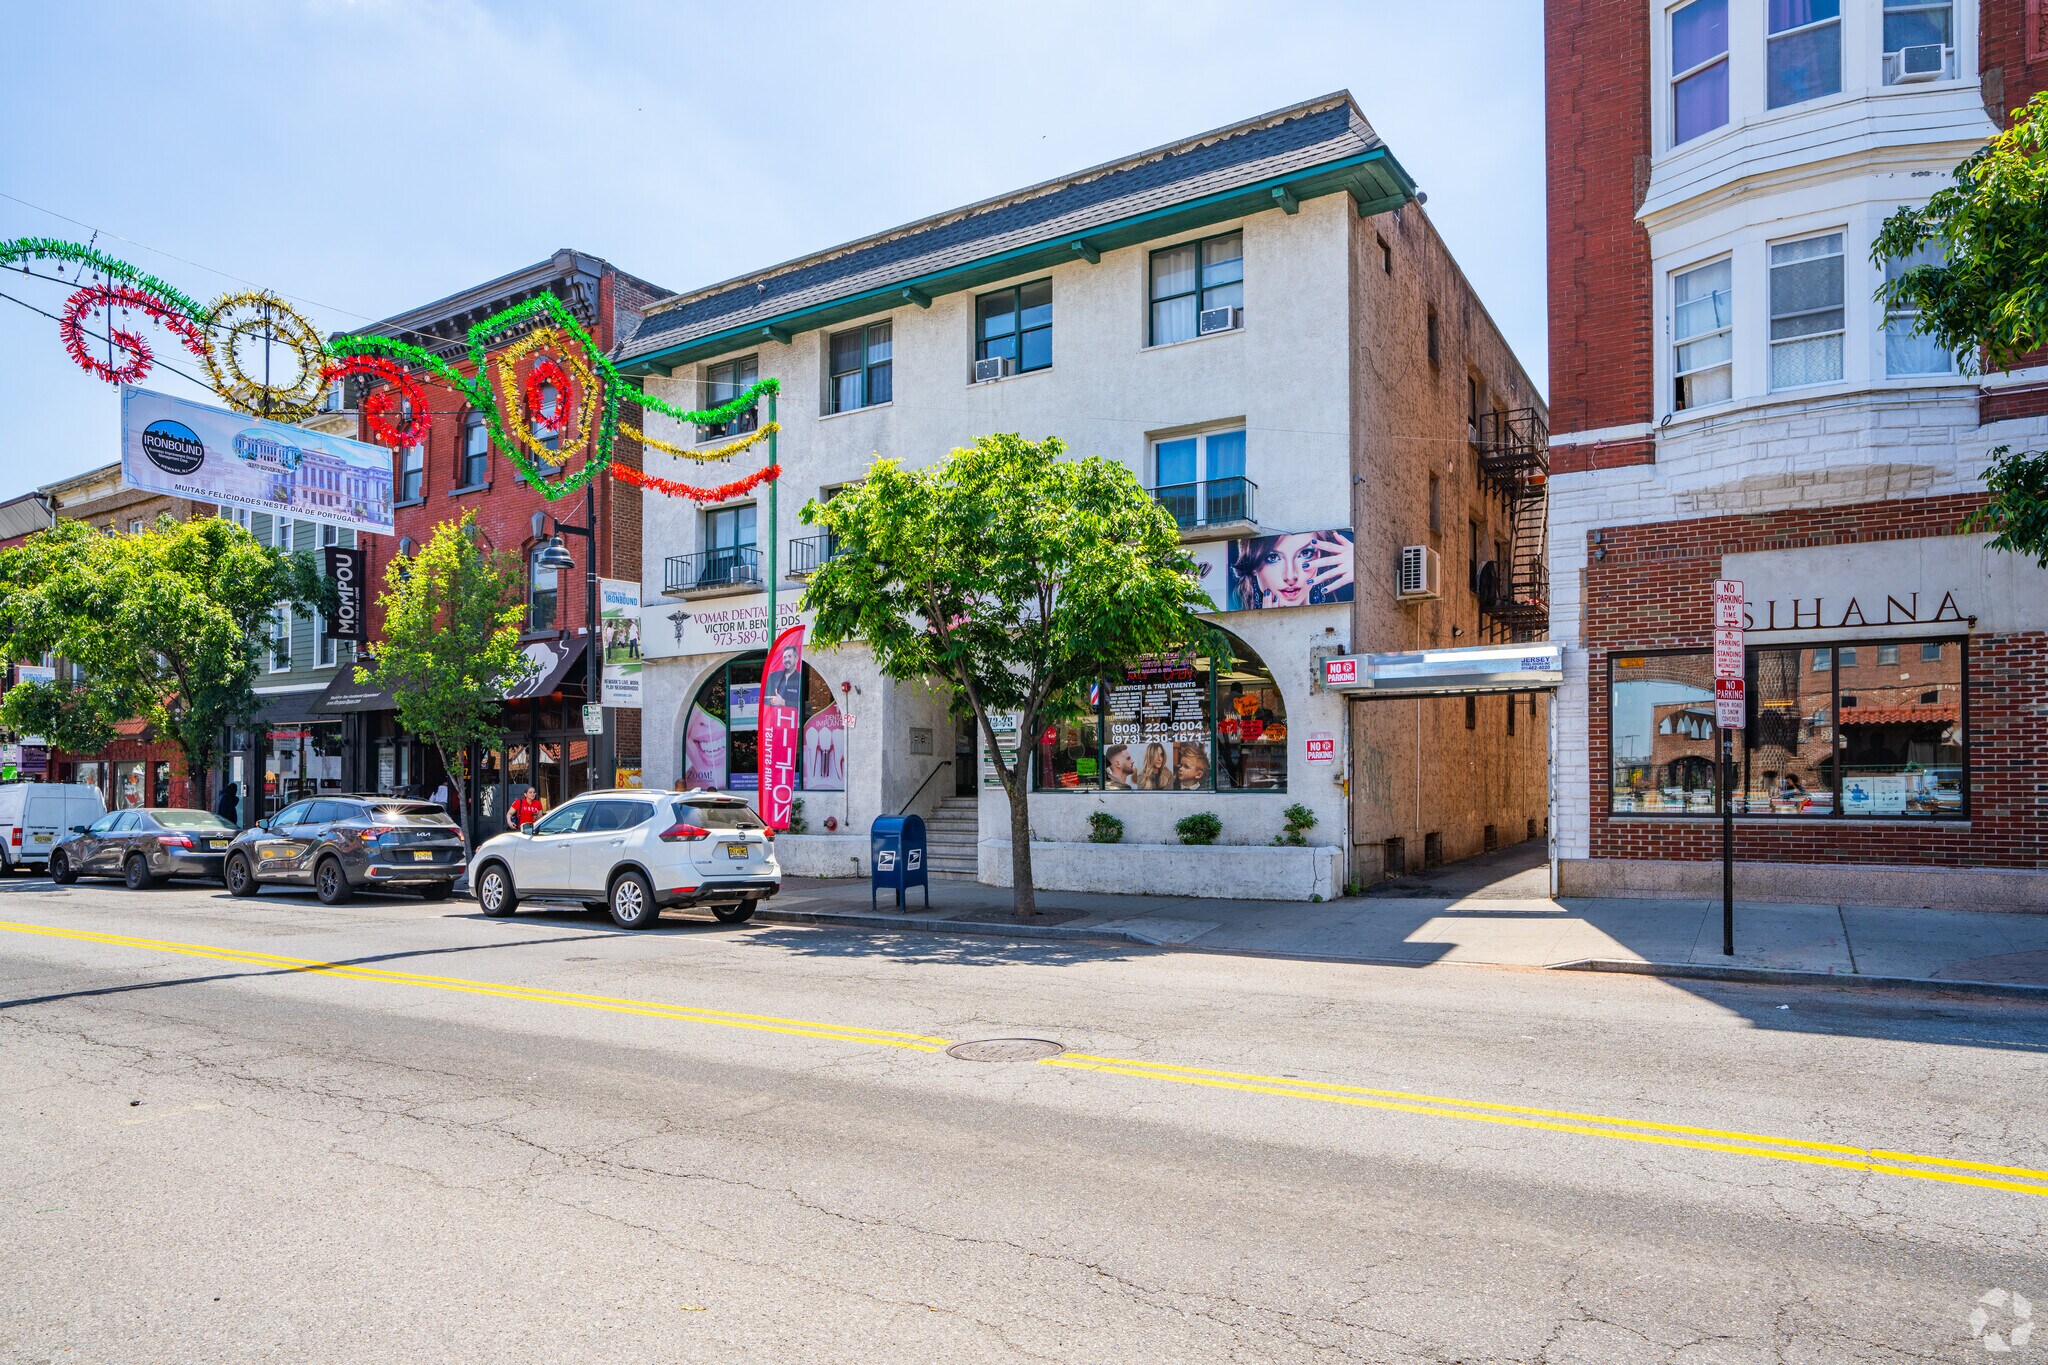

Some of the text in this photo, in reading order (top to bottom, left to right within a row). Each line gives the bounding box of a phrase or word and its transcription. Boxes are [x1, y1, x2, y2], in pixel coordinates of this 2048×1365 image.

[144, 434, 202, 456] IRONBOUND
[174, 484, 356, 523] MUITAS FELICIDADES NESTE DIA DE PORTUGAL
[336, 554, 354, 634] MOMPOU
[1724, 584, 1735, 593] NO
[606, 594, 638, 606] IRONBOUND
[1717, 594, 1743, 604] PARKING
[694, 610, 729, 624] VOMAR
[732, 606, 768, 620] DENTAL
[704, 622, 735, 633] VICTOR
[737, 622, 747, 630] M.
[781, 615, 800, 626] DDS
[1164, 668, 1192, 680] OPEN
[1330, 664, 1341, 673] NO
[1328, 673, 1355, 682] PARKING
[1726, 681, 1736, 690] NO
[1717, 690, 1743, 699] PARKING
[1112, 721, 1203, 734] (908) 220-6004
[1112, 733, 1203, 744] (973) 230-1671
[1310, 742, 1321, 751] NO
[687, 771, 713, 780] ZOOM!
